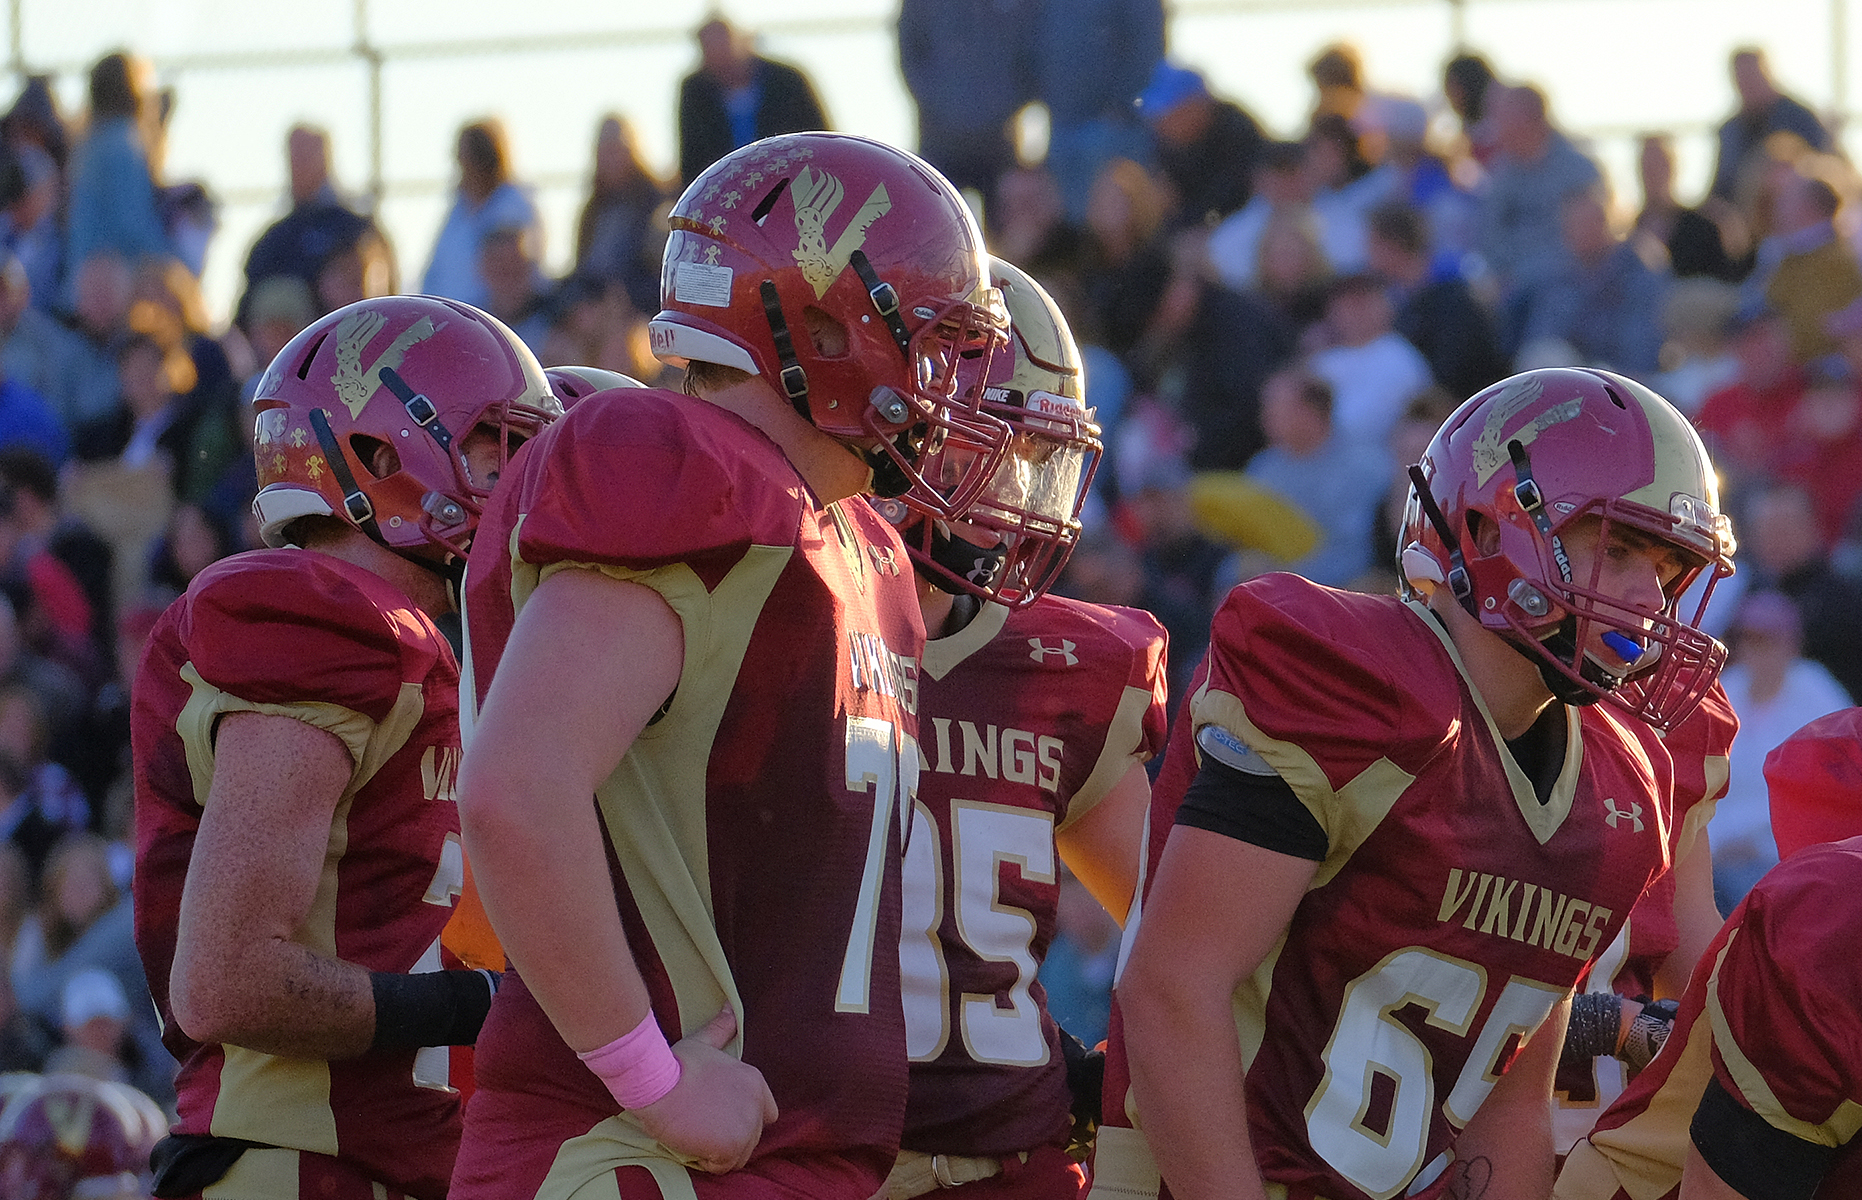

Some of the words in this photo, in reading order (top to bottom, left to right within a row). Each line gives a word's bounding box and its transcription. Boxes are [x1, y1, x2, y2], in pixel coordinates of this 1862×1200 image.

[982, 387, 1010, 403] NIKE
[1552, 535, 1571, 584] Ridde
[919, 716, 1065, 793] INGS
[1437, 867, 1614, 962] VIKINGS
